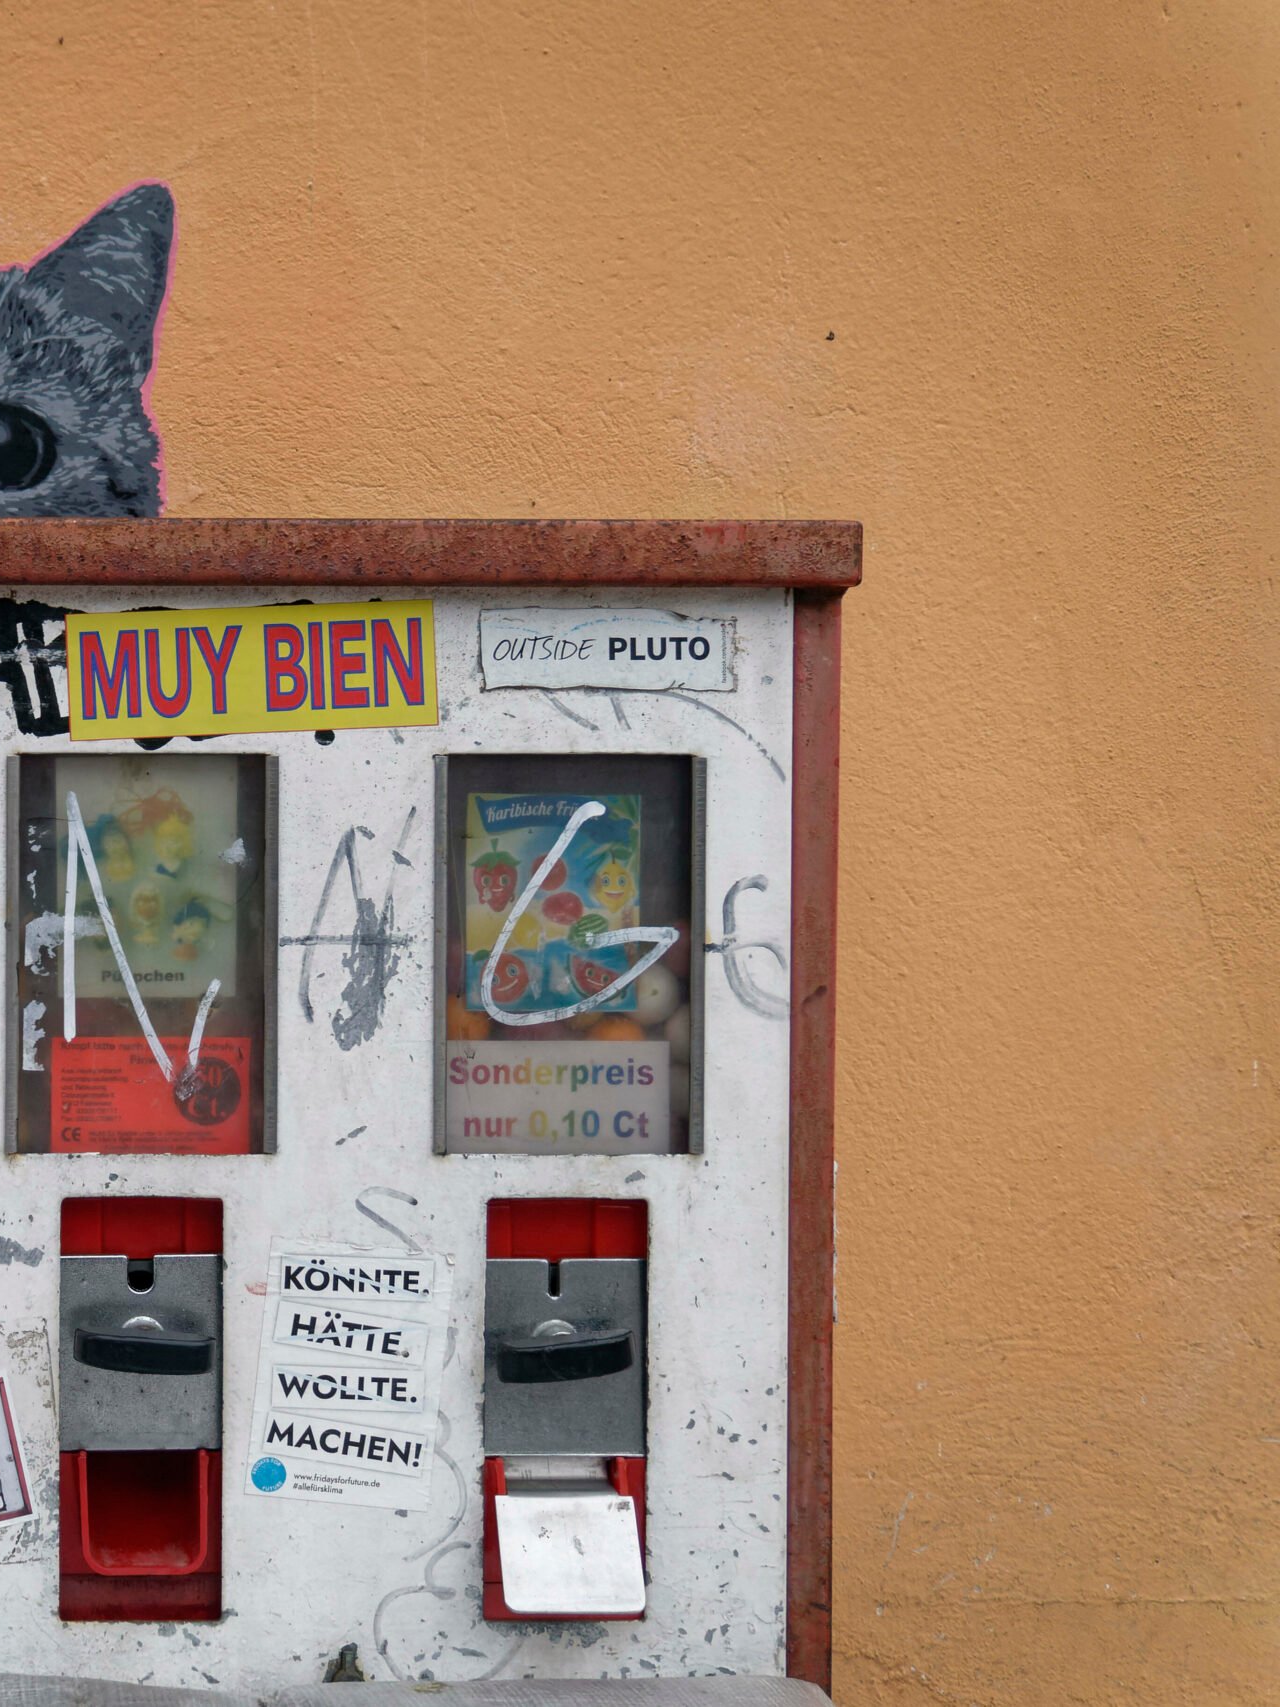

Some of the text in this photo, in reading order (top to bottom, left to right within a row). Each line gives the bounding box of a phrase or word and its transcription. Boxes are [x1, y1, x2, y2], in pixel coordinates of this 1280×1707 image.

[492, 635, 710, 662] OUTSIDE PLUTO
[79, 617, 426, 720] MUY BIEN
[486, 801, 553, 823] Karibische
[448, 1056, 655, 1092] Sonderpreis
[463, 1110, 649, 1143] nur 0,10 Ct
[266, 1419, 423, 1468] MACHEN!
[292, 1483, 343, 1495] #allefürsklima
[293, 1473, 381, 1488] www.fridaysforfuture.de
